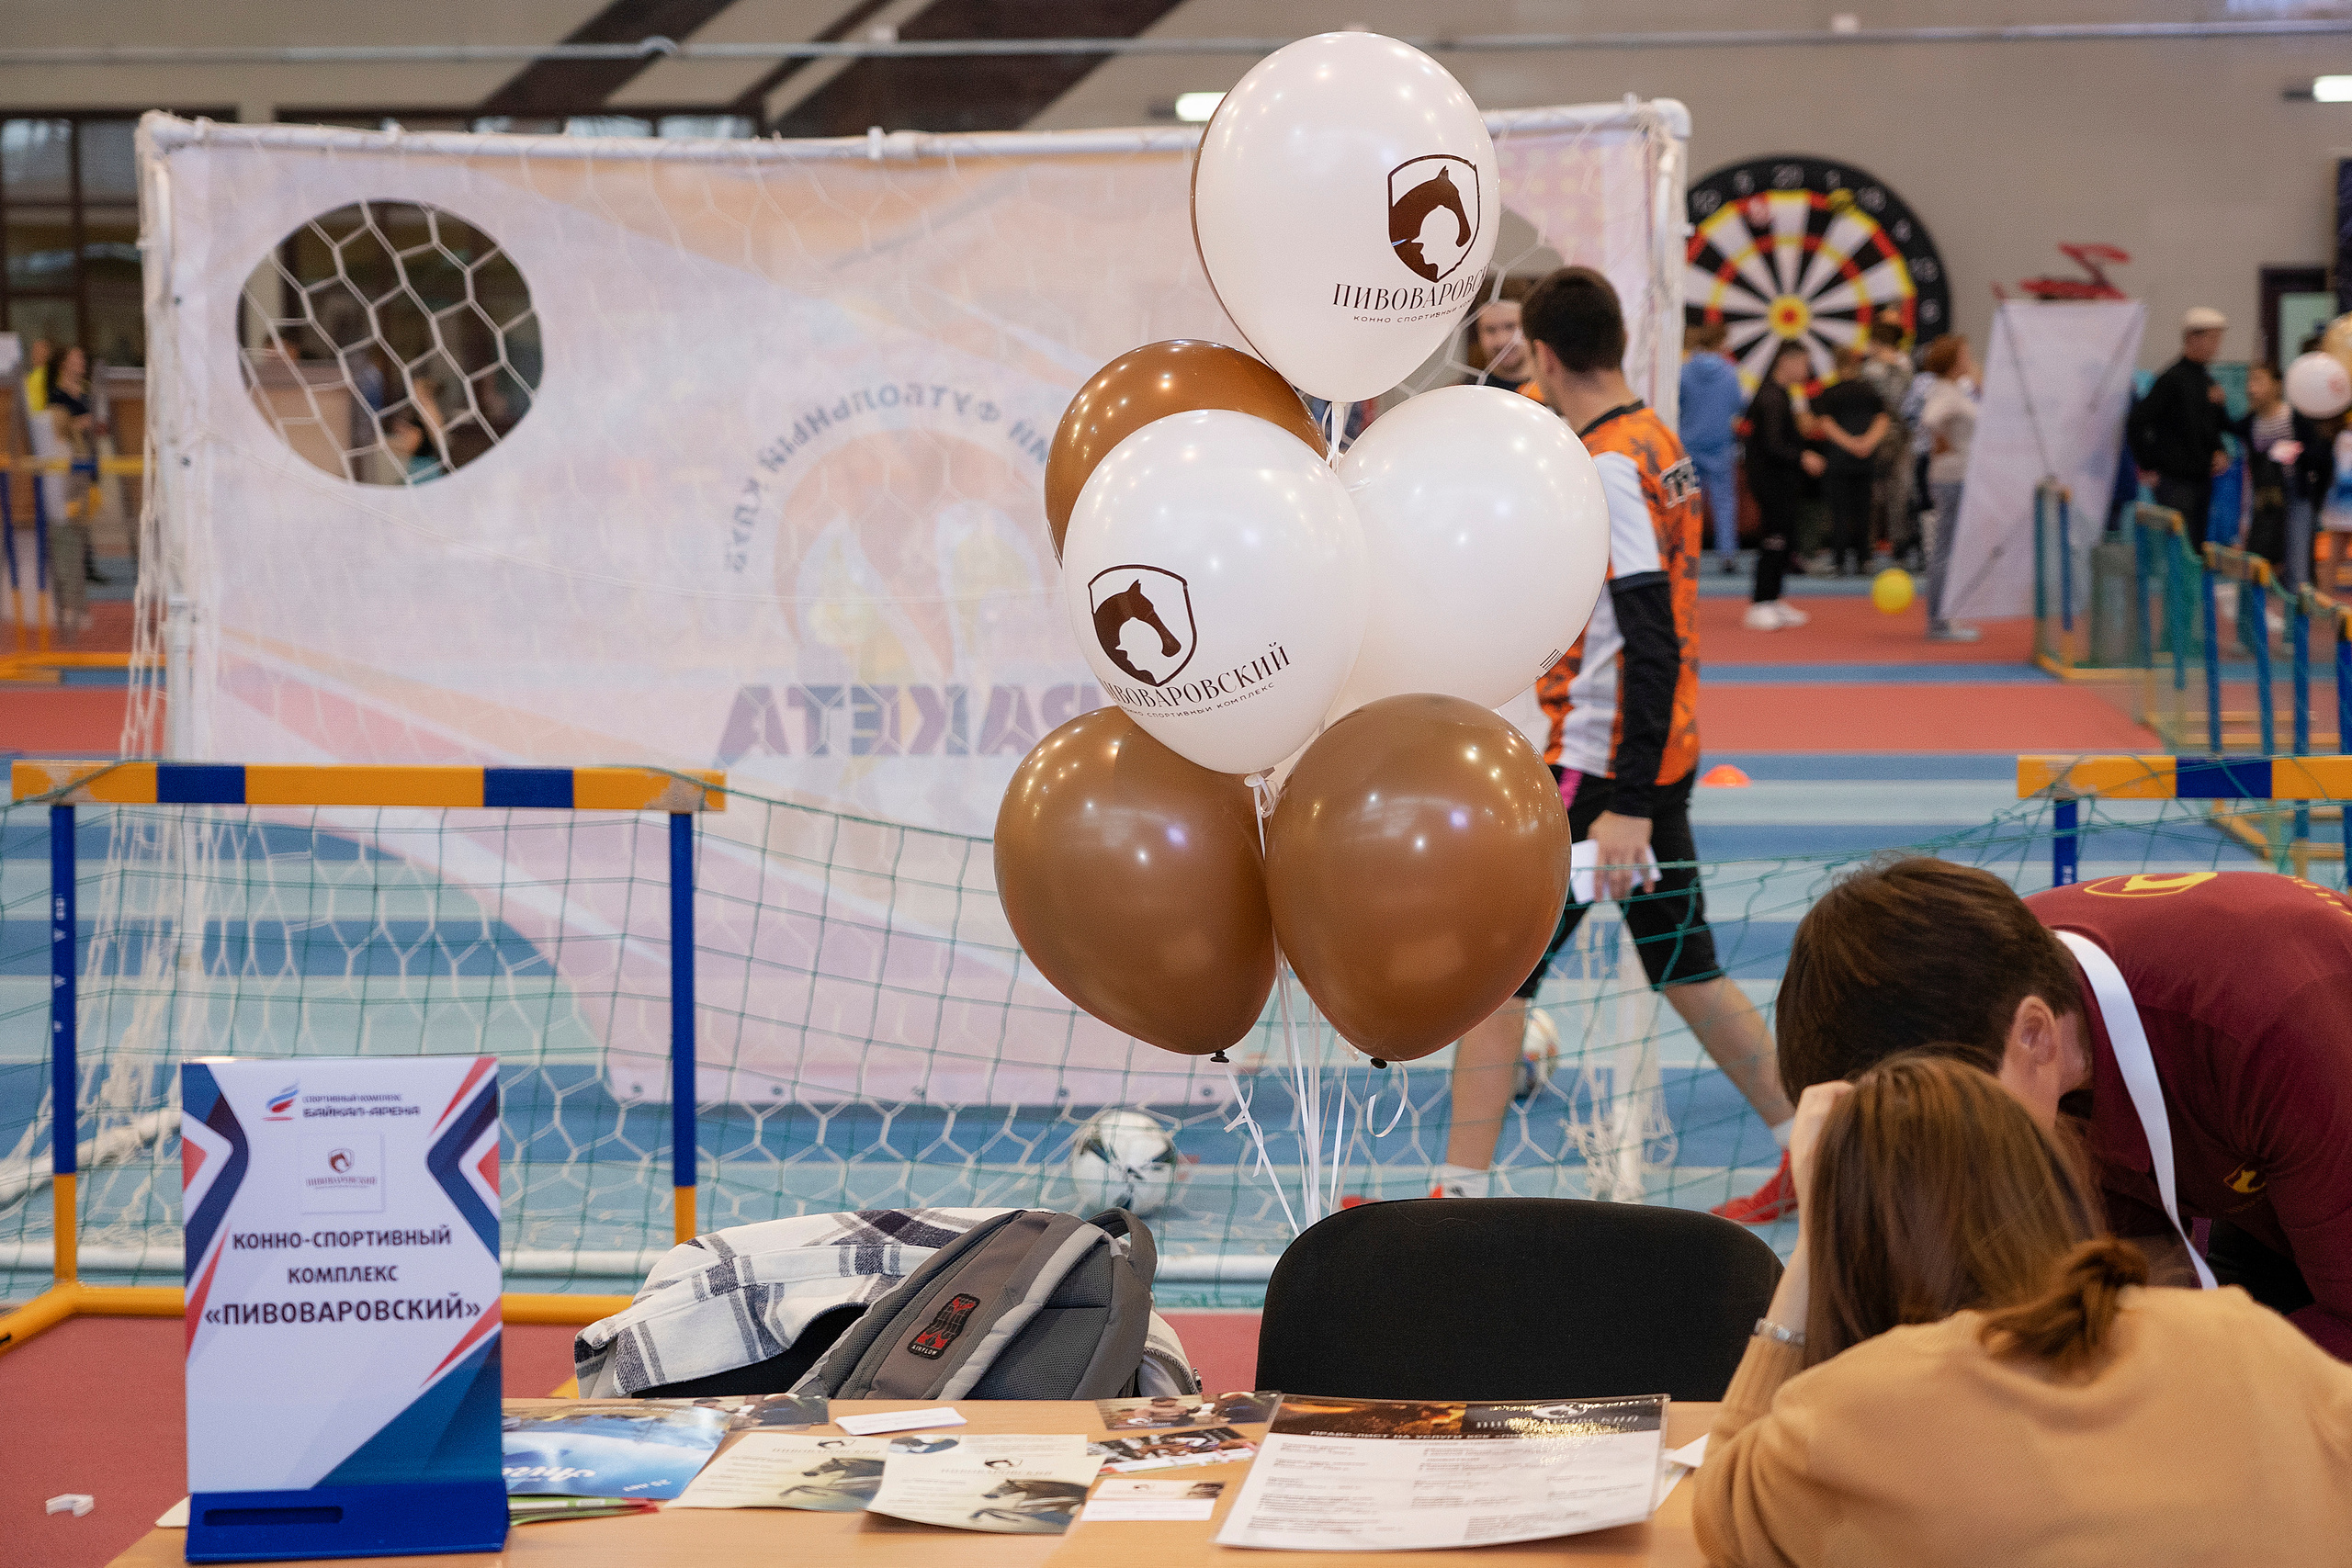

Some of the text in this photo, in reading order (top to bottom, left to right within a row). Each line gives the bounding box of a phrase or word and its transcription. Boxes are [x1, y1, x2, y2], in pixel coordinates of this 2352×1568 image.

[1353, 315, 1391, 323] КОННО
[1216, 682, 1275, 709] КОМПЛЕКС
[303, 1105, 421, 1118] БАЙКАЛ-АРЕНА
[232, 1224, 452, 1249] КОННО-СПОРТИВНЫЙ
[287, 1265, 398, 1284] КОМПЛЕКС
[205, 1292, 481, 1325] «ПИВОВАРОВСКИЙ»
